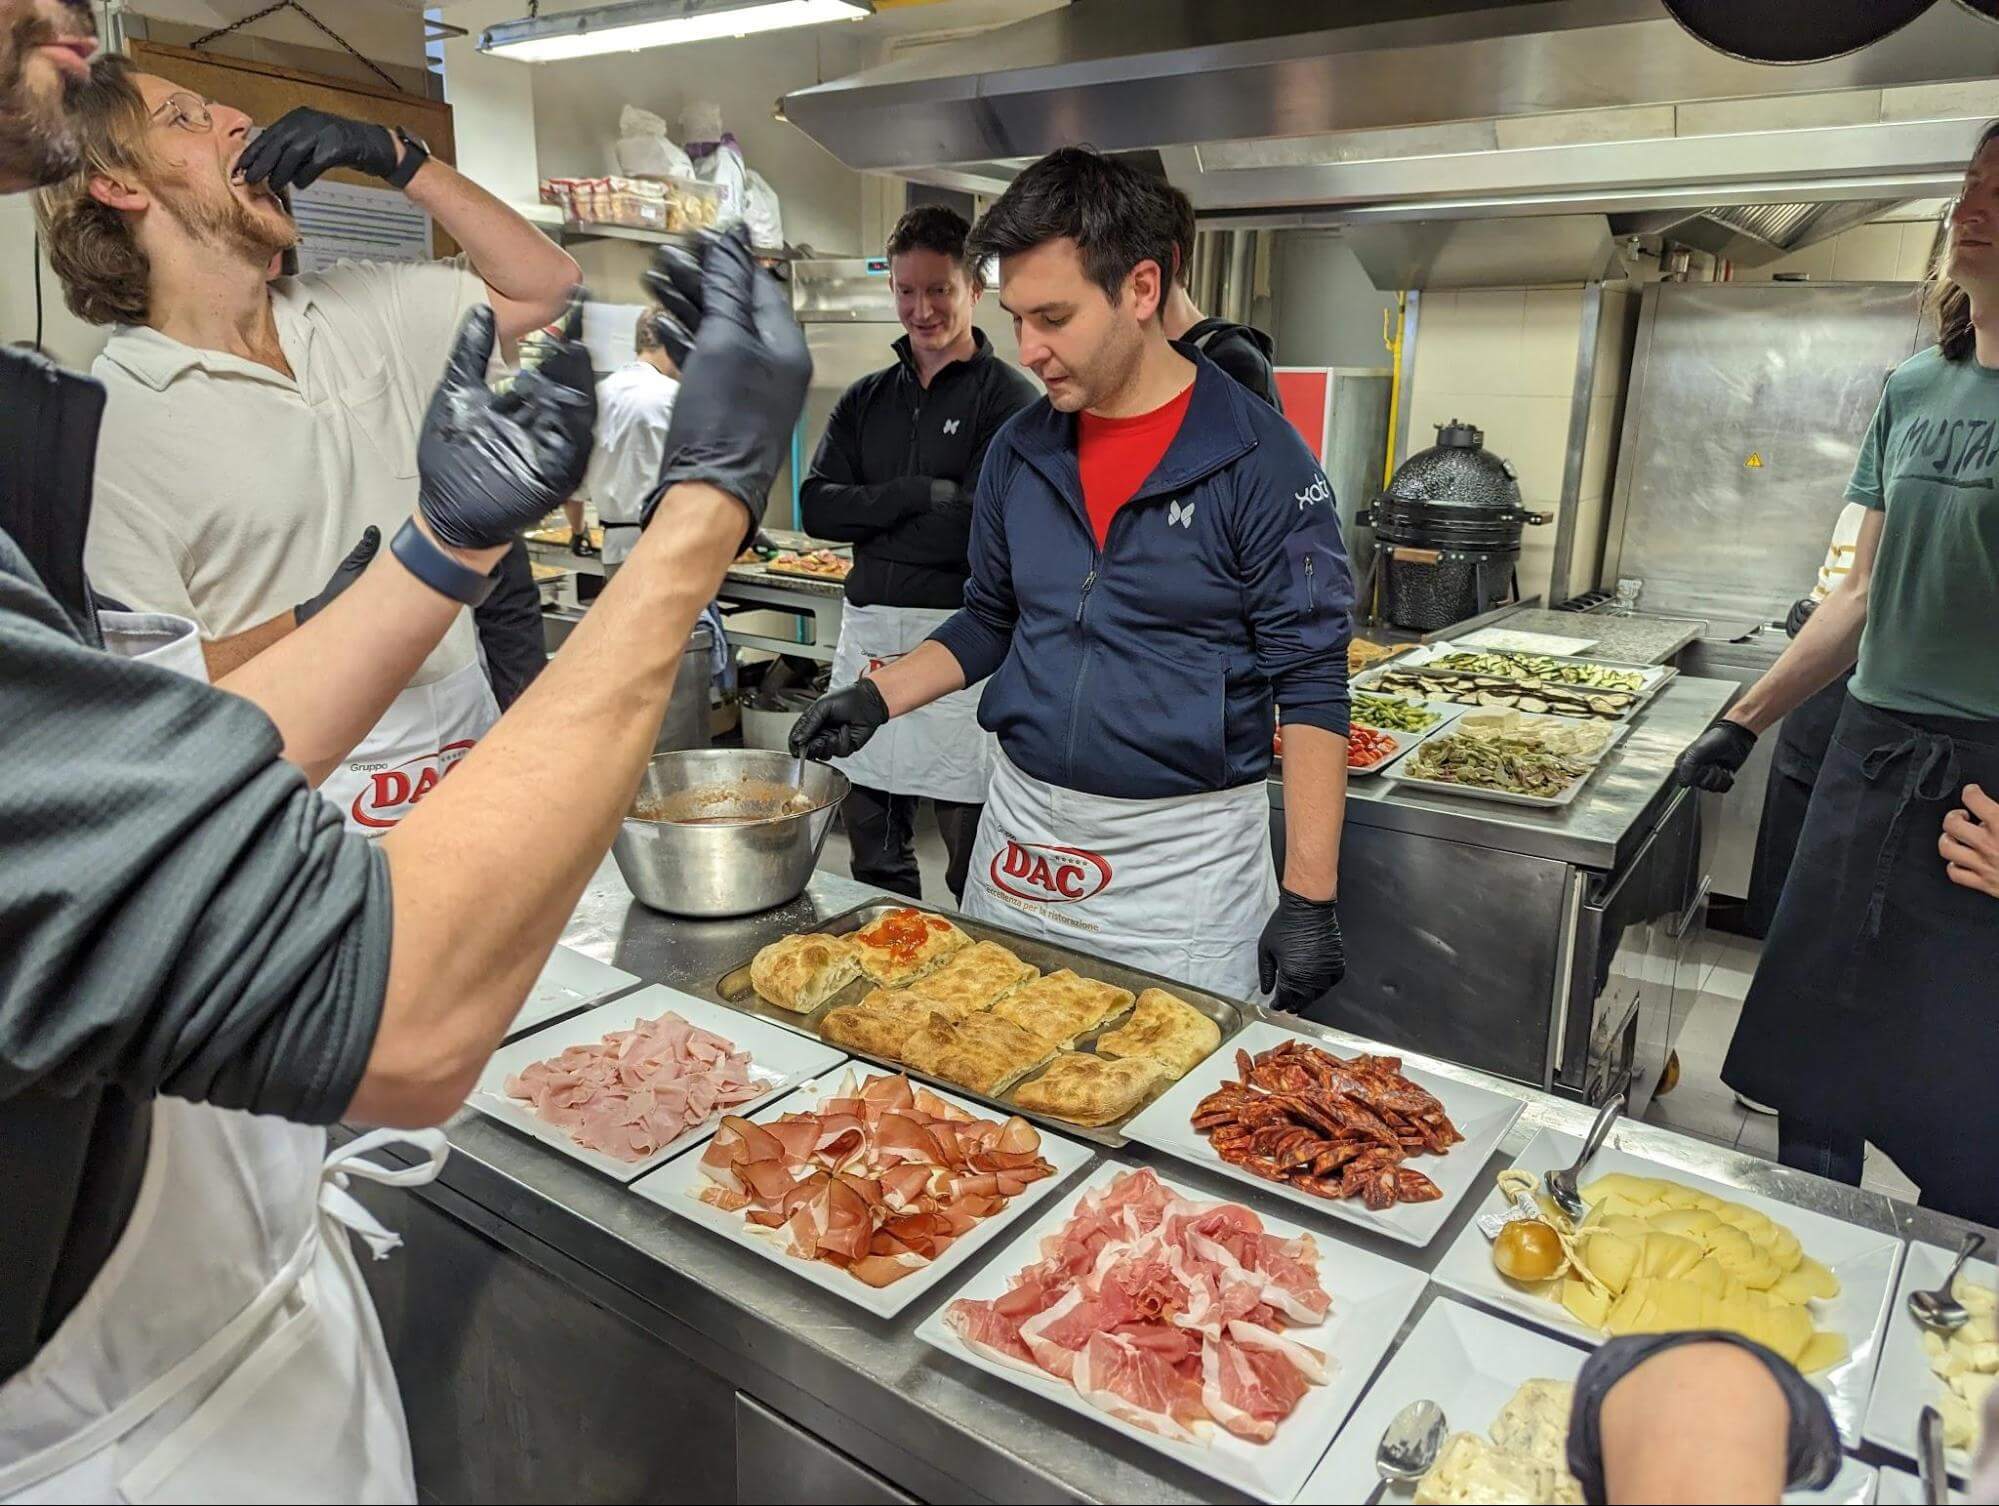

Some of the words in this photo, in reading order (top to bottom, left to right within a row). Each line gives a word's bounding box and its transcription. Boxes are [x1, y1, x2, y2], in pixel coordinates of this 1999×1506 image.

[350, 762, 388, 773] Gruppo
[371, 757, 463, 809] DA
[1002, 840, 1085, 898] DAC
[1023, 903, 1037, 912] per
[1047, 910, 1100, 932] ristorazione
